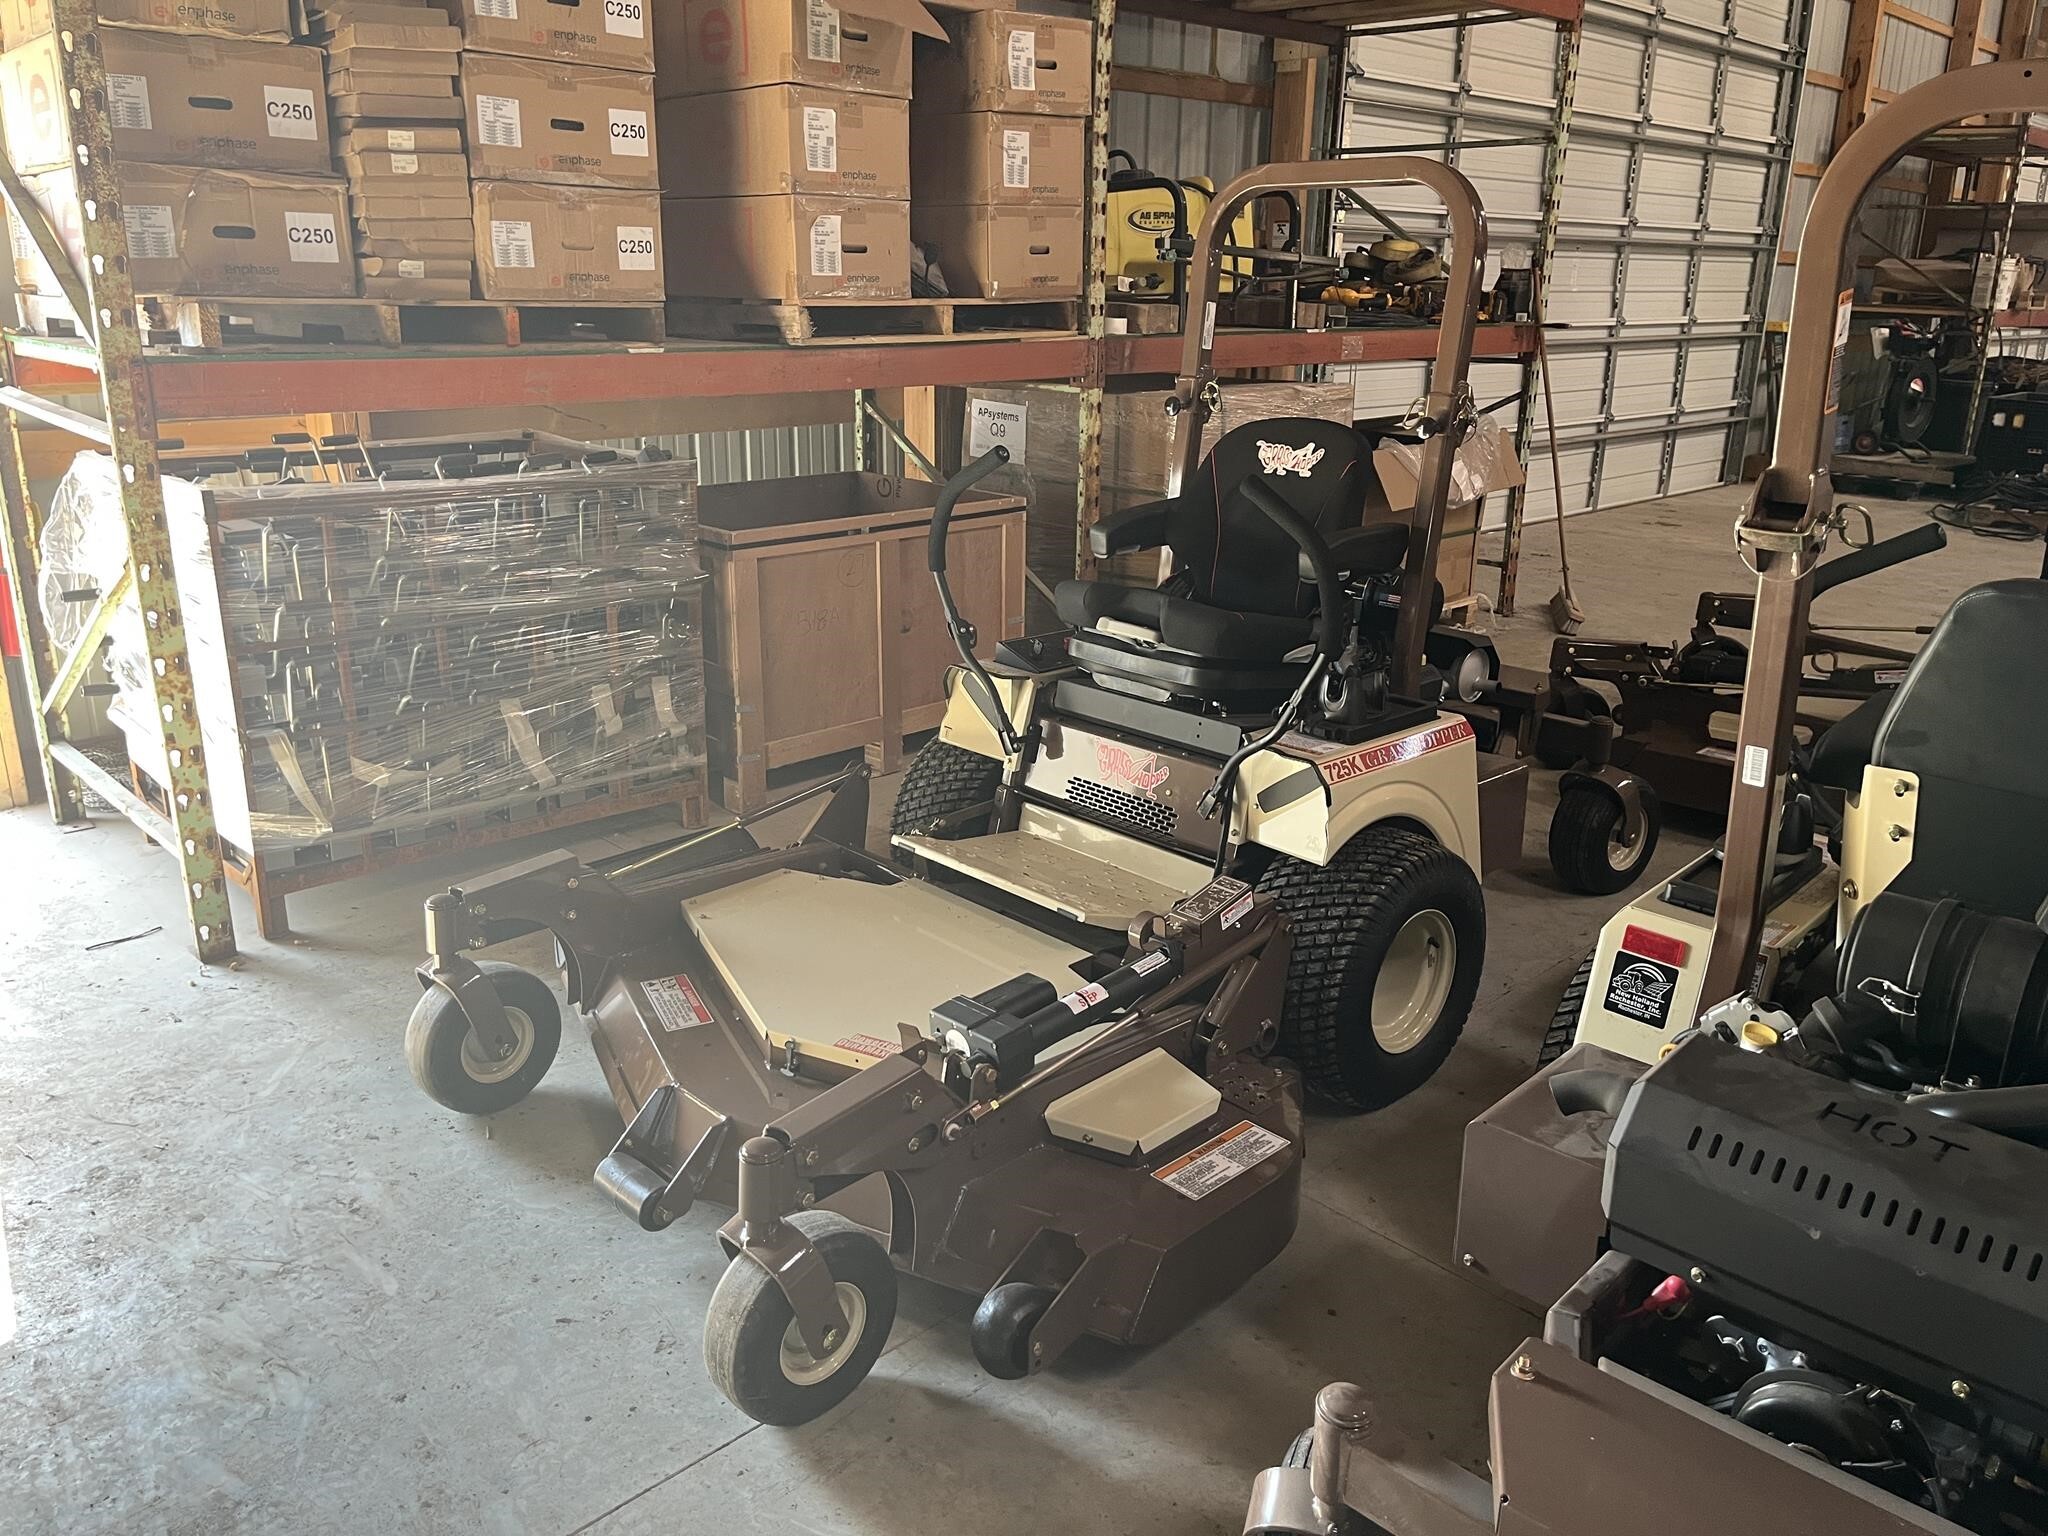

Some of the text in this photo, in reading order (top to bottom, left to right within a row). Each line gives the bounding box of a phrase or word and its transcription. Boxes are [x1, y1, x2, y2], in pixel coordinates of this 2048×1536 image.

[177, 4, 236, 22] enphase
[605, 1, 641, 20] C250
[553, 29, 598, 44] enphase
[267, 101, 313, 121] C250
[610, 122, 646, 140] C250
[200, 136, 257, 151] enphase
[558, 154, 602, 168] enphase
[842, 170, 877, 182] enphase
[1140, 211, 1175, 220] AG SPRA
[288, 227, 334, 244] C250
[619, 239, 653, 254] C250
[224, 263, 280, 277] enphase
[568, 271, 611, 284] enphase
[978, 407, 1020, 422] APsystems
[990, 422, 1006, 438] Q9
[1323, 755, 1363, 782] 725K
[1366, 723, 1466, 768] GRAOPPER
[1078, 991, 1098, 1008] SEP
[1615, 988, 1660, 1009] New Holland
[1647, 1006, 1662, 1016] Inc.
[1816, 1102, 1970, 1162] HOT
